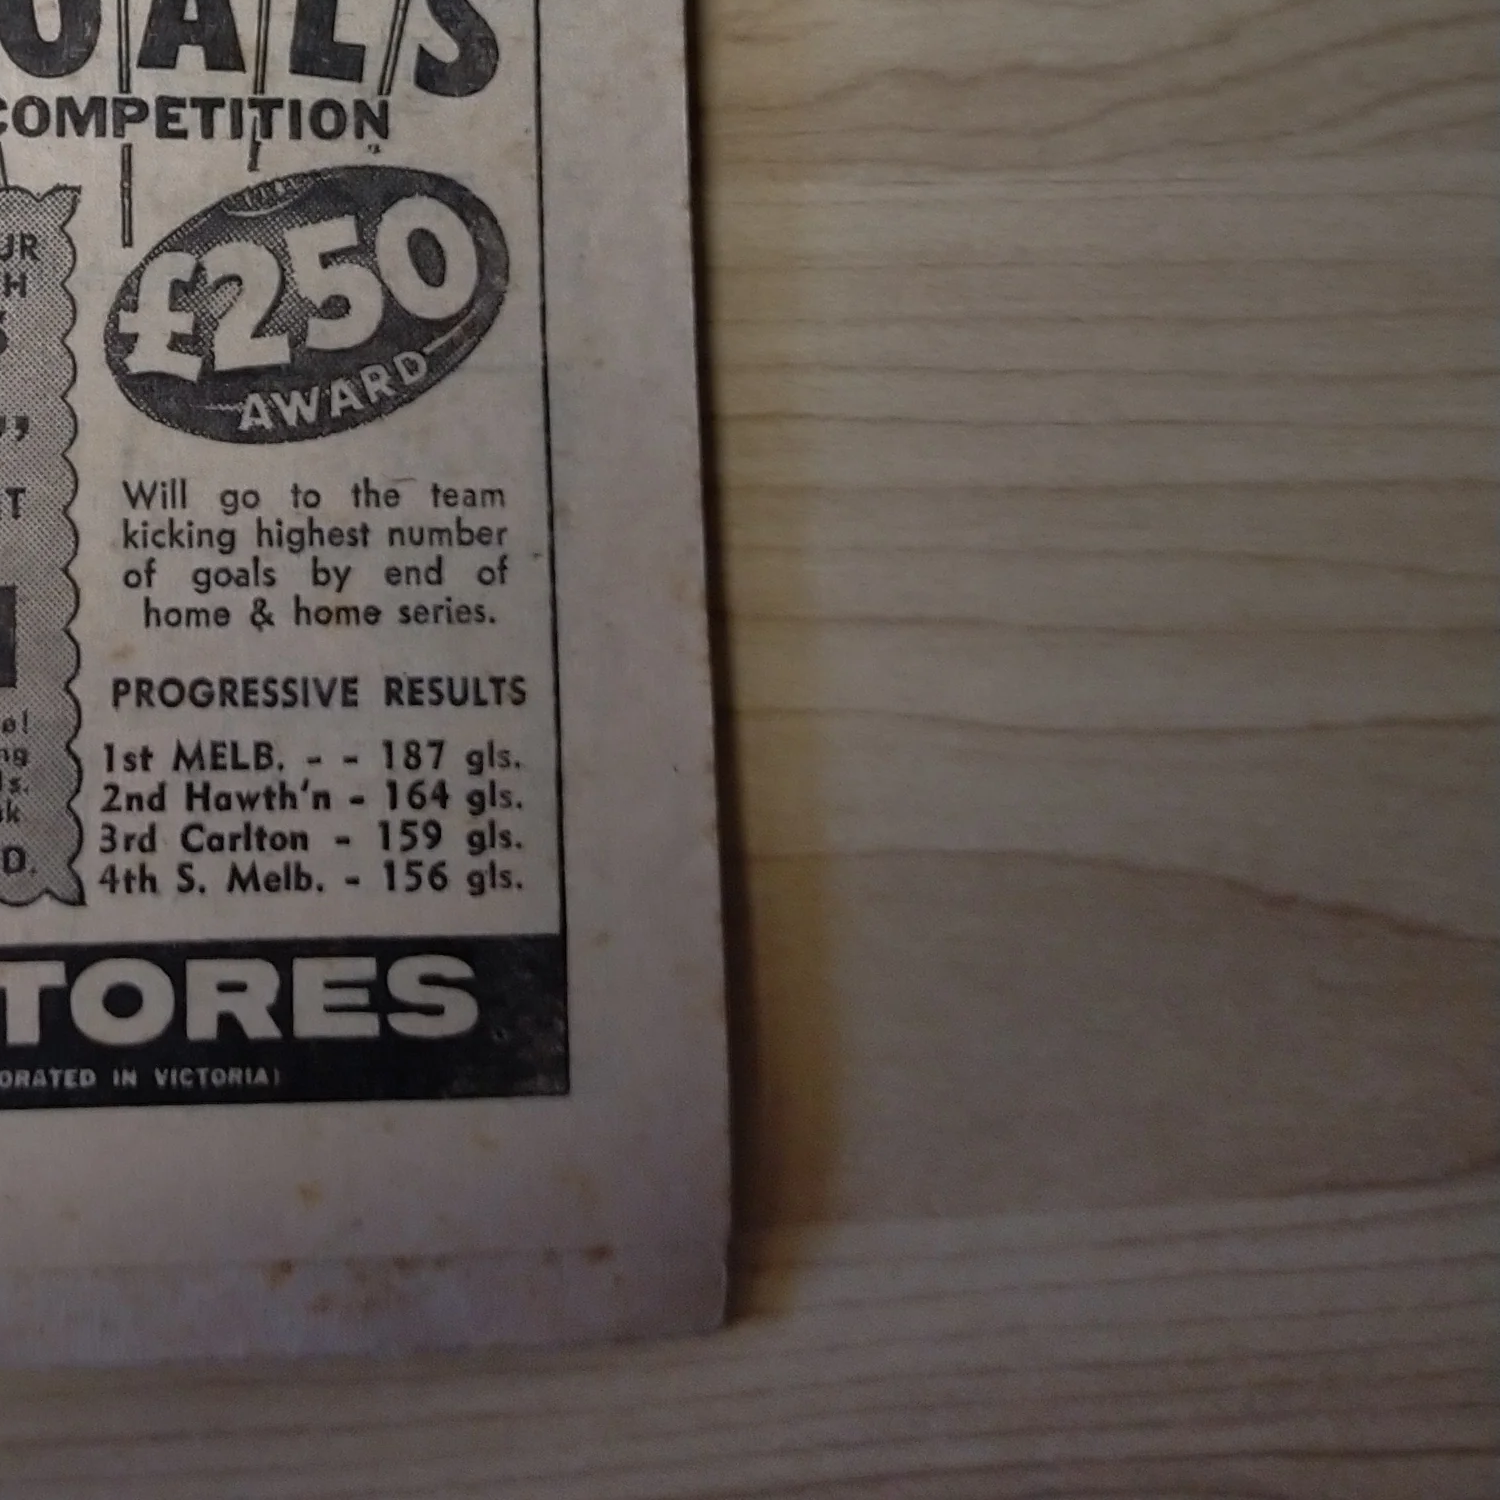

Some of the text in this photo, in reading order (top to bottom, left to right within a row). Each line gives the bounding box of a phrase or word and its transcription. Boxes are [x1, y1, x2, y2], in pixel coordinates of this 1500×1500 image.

[119, 195, 478, 382] £250
[239, 351, 428, 432] AWARD
[123, 477, 505, 515] Will go to the team
[123, 516, 507, 554] kicking highest number
[123, 554, 509, 594] of goals by end of
[144, 595, 495, 631] home & home series.
[112, 675, 526, 710] PROGRESSIVE RESULTS
[103, 743, 153, 772] 1st
[173, 740, 284, 771] MELB.
[382, 740, 446, 771] 187
[466, 739, 521, 775] gls.
[100, 782, 166, 812] 2nd
[185, 780, 331, 811] Hawth'n
[386, 779, 449, 810] 164
[466, 780, 522, 816] gls.
[100, 822, 156, 853] 3rd
[180, 822, 308, 852] Carlton
[379, 820, 442, 851] 159
[466, 819, 522, 855] gls.
[99, 863, 157, 894] 4th
[176, 863, 206, 893] S.
[227, 861, 324, 893] Melb.
[384, 860, 448, 892] 156
[466, 860, 522, 896] gls.
[113, 1067, 137, 1087] IN
